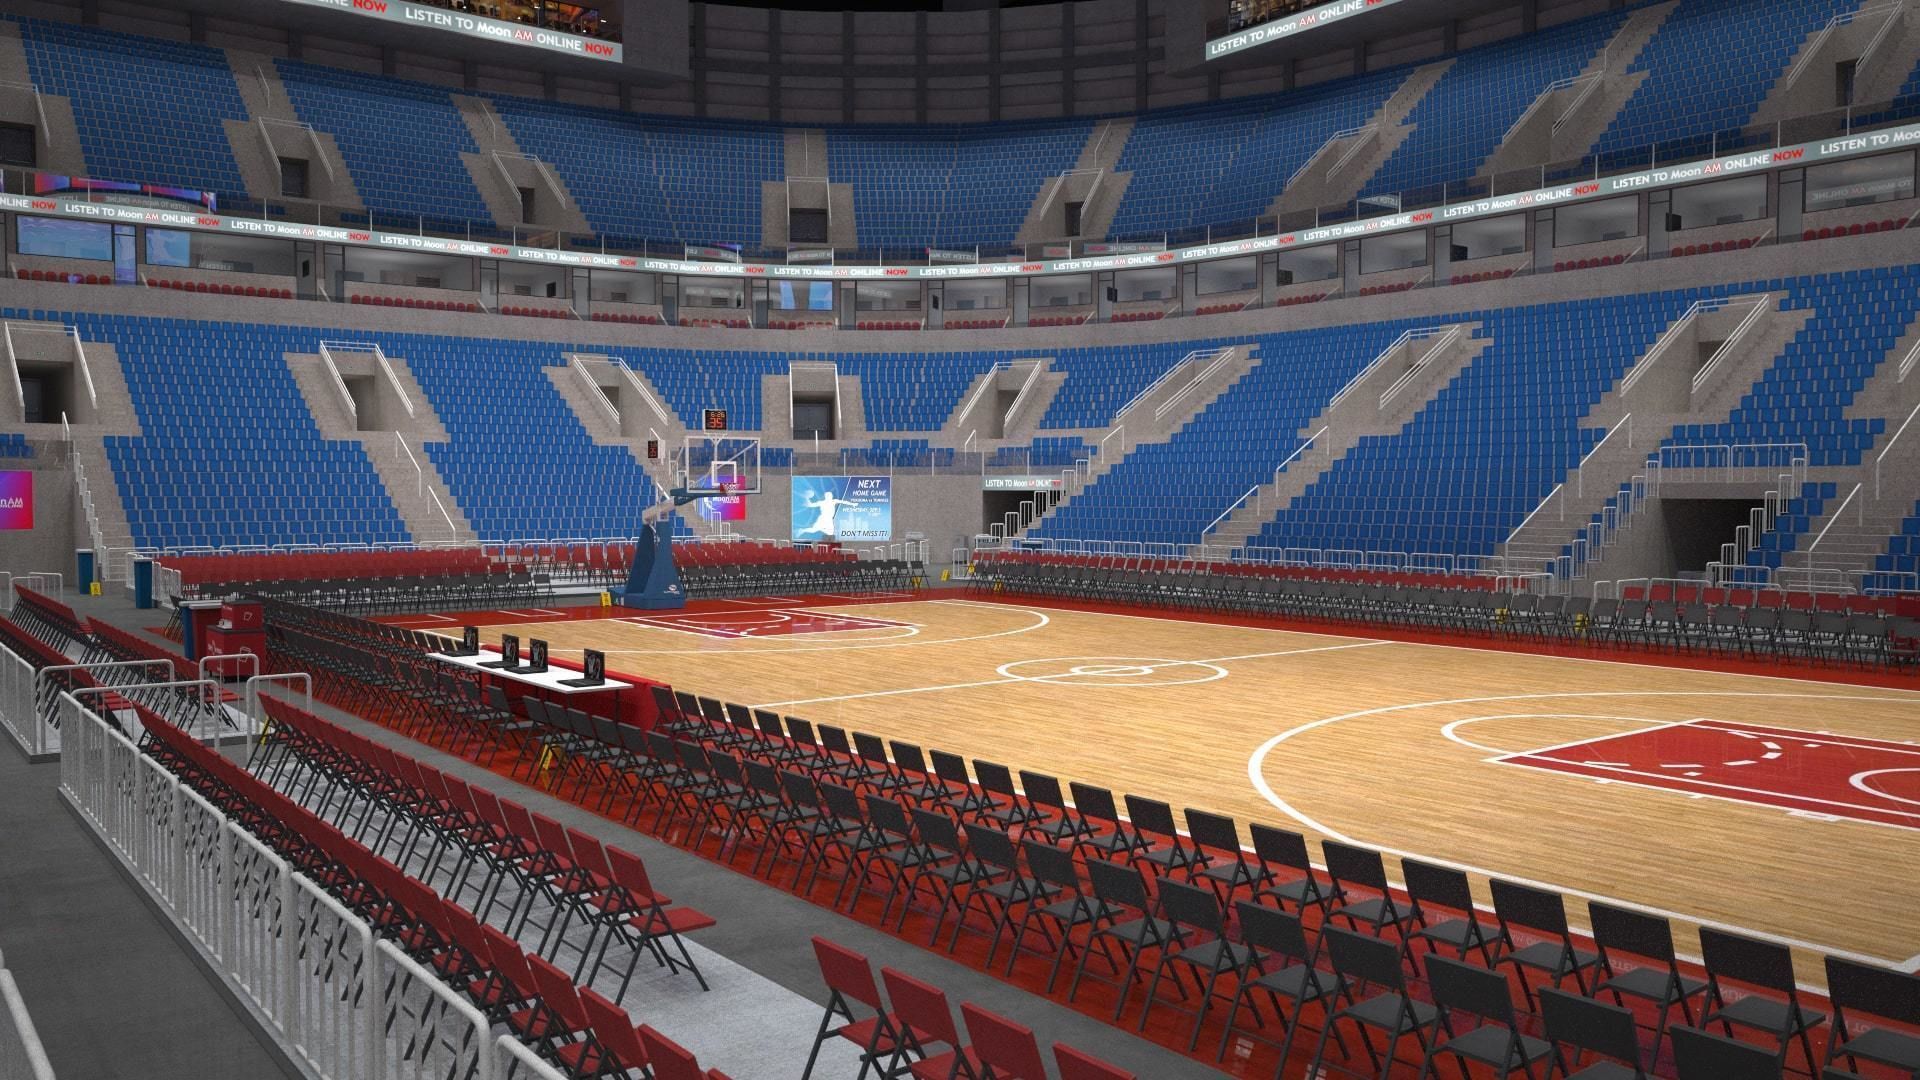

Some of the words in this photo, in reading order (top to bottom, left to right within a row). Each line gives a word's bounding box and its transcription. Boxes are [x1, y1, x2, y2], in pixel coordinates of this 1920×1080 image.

[353, 0, 387, 13] NOW
[405, 7, 451, 25] LISTEN
[455, 16, 474, 30] TO
[477, 23, 511, 38] Moon
[514, 28, 533, 41] AM
[536, 33, 581, 50] ONLINE
[584, 42, 614, 57] NOW
[1212, 35, 1247, 55] LISTEN
[1249, 29, 1265, 43] TO
[1267, 23, 1296, 39] Moon
[1299, 13, 1316, 27] AM
[1319, 0, 1363, 20] ONLINE
[1821, 137, 1866, 154] LISTEN
[1870, 134, 1889, 146] TO
[1612, 175, 1650, 190] LISTEN
[1652, 171, 1668, 182] TO
[1670, 167, 1701, 180] Moon
[1703, 162, 1722, 174] AM
[1725, 154, 1770, 170] ONLINE
[1772, 148, 1805, 162] NOW
[32, 200, 56, 209] NOW
[1443, 204, 1475, 218] LISTEN
[1476, 202, 1490, 212] TO
[1491, 198, 1518, 210] Moon
[1518, 194, 1534, 205] AM
[1535, 187, 1573, 202] ONLINE
[1574, 183, 1600, 196] NOW
[65, 204, 99, 216] LISTEN
[101, 207, 115, 217] TO
[117, 209, 143, 220] Moon
[144, 212, 159, 221] AM
[161, 213, 196, 225] ONLINE
[198, 217, 220, 227] NOW
[231, 220, 261, 231] LISTEN
[263, 224, 276, 233] TO
[277, 225, 300, 236] Moon
[302, 227, 315, 237] AM
[316, 229, 348, 240] ONLINE
[349, 233, 370, 241] NOW
[1303, 229, 1330, 241] LISTEN
[1331, 227, 1342, 236] TO
[1343, 224, 1365, 235] Moon
[1366, 221, 1378, 231] AM
[1380, 215, 1411, 228] ONLINE
[1412, 211, 1433, 223] NOW
[380, 235, 409, 246] LISTEN
[409, 238, 422, 247] TO
[423, 239, 445, 249] Moon
[446, 241, 458, 250] AM
[460, 243, 489, 254] ONLINE
[1182, 249, 1207, 259] LISTEN
[1208, 247, 1218, 256] TO
[1219, 245, 1239, 254] Moon
[1240, 242, 1252, 251] AM
[1253, 238, 1278, 250] ONLINE
[1279, 235, 1295, 244] NOW
[518, 249, 544, 259] LISTEN
[545, 252, 557, 261] TO
[559, 254, 580, 263] Moon
[580, 256, 592, 264] AM
[593, 256, 619, 266] ONLINE
[619, 258, 637, 266] NOW
[1053, 261, 1080, 271] LISTEN
[1081, 260, 1092, 269] TO
[1093, 259, 1113, 268] Moon
[1114, 257, 1126, 266] AM
[1127, 255, 1156, 265] ONLINE
[1157, 253, 1175, 262] NOW
[644, 261, 668, 270] LISTEN
[669, 263, 679, 271] TO
[680, 263, 699, 272] Moon
[700, 264, 713, 272] AM
[714, 264, 744, 273] ONLINE
[746, 266, 765, 274] NOW
[774, 267, 800, 276] LISTEN
[802, 268, 812, 276] TO
[813, 268, 833, 276] Moon
[834, 268, 848, 276] AM
[850, 268, 884, 276] ONLINE
[886, 268, 908, 276] NOW
[919, 267, 946, 276] LISTEN
[947, 267, 958, 275] TO
[959, 266, 979, 275] Moon
[980, 266, 992, 274] AM
[992, 264, 1020, 273] ONLINE
[1022, 264, 1043, 273] NOW
[857, 479, 882, 489] NEXT
[985, 479, 1004, 487] LISTEN
[1004, 479, 1013, 487] TO
[1013, 479, 1028, 488] Moon
[852, 489, 869, 497] HOME
[870, 489, 887, 497] GAME
